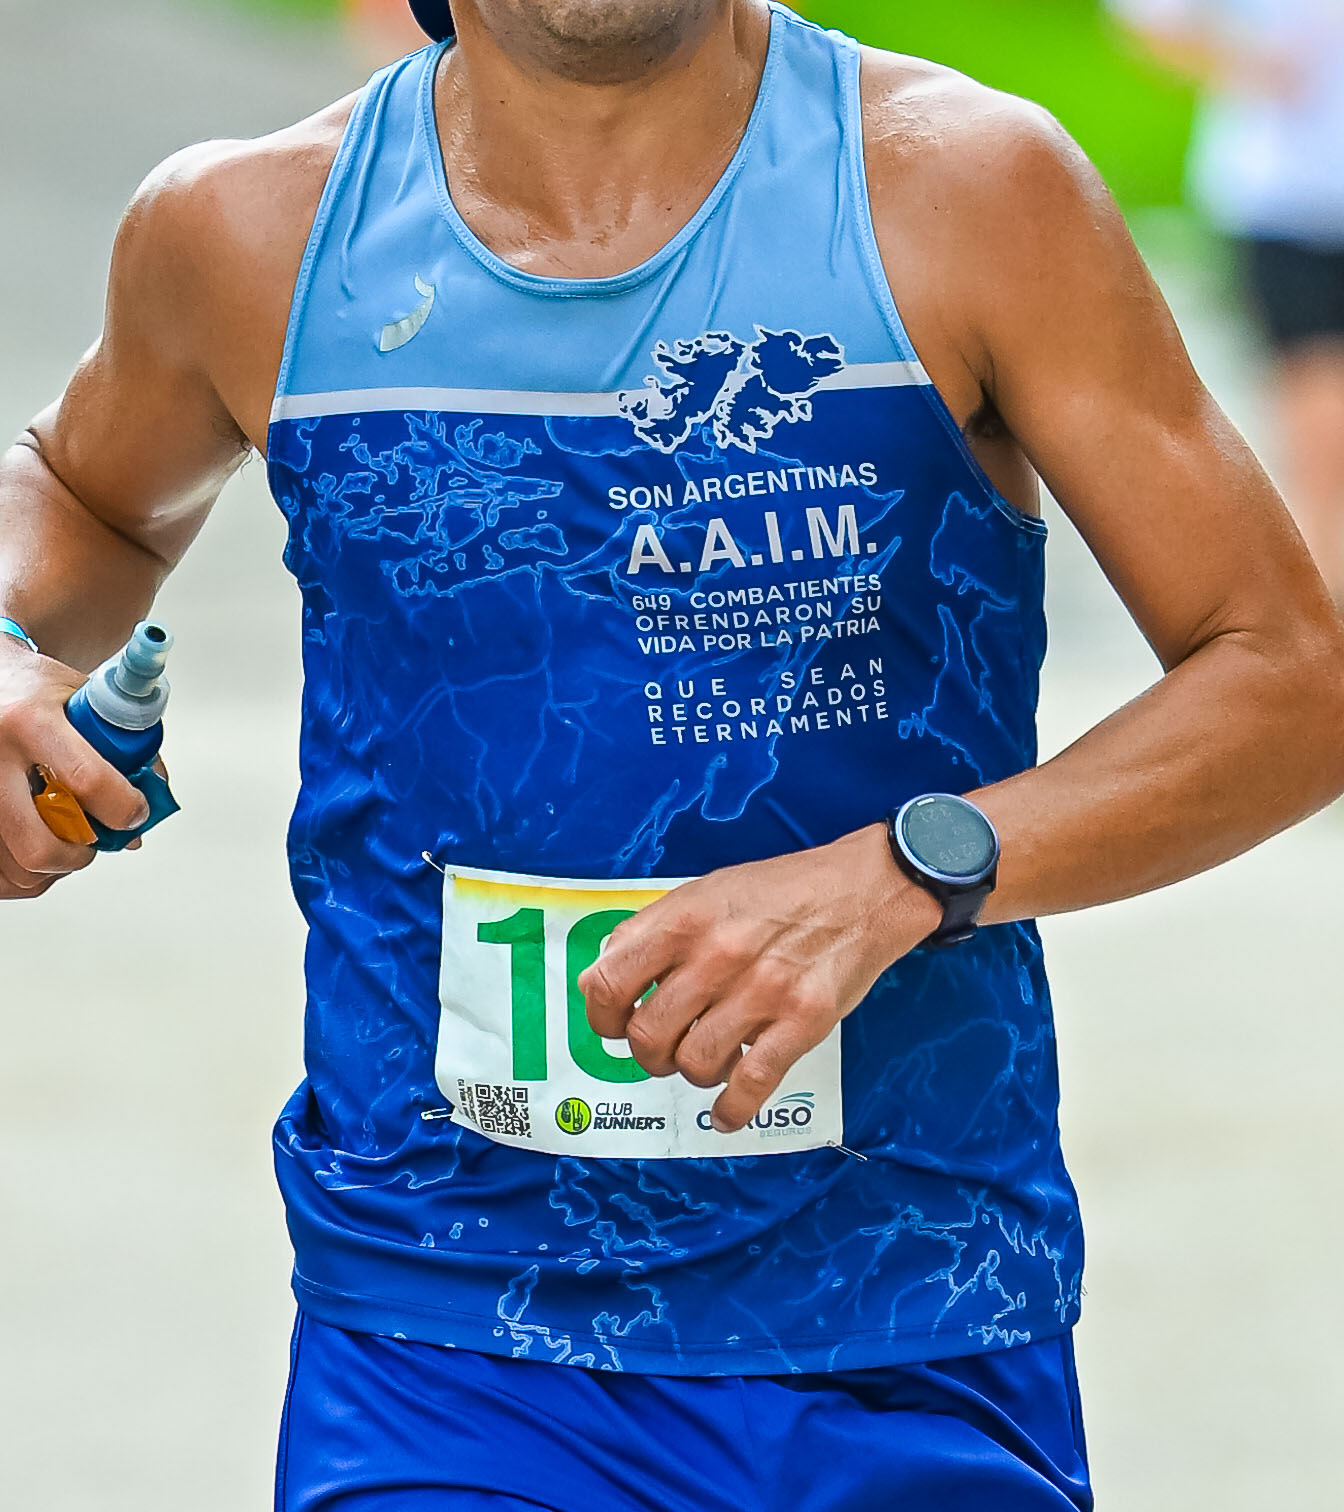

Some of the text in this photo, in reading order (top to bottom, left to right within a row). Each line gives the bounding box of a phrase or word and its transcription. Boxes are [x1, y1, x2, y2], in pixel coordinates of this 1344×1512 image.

[608, 462, 878, 510] SON ARGENTINAS
[626, 504, 877, 575] A.A.I.M.
[633, 574, 882, 611] 649 COMBATIENTES
[636, 596, 881, 632] OFRENDARON SU
[637, 616, 880, 654] VIDA POR LA PATRIA
[644, 658, 882, 699] QUE SEAN
[648, 680, 885, 723] RECORDADOS
[651, 702, 889, 745] ETERNAMENTE
[595, 1102, 632, 1116] CLUB
[696, 1106, 812, 1131] CUSO
